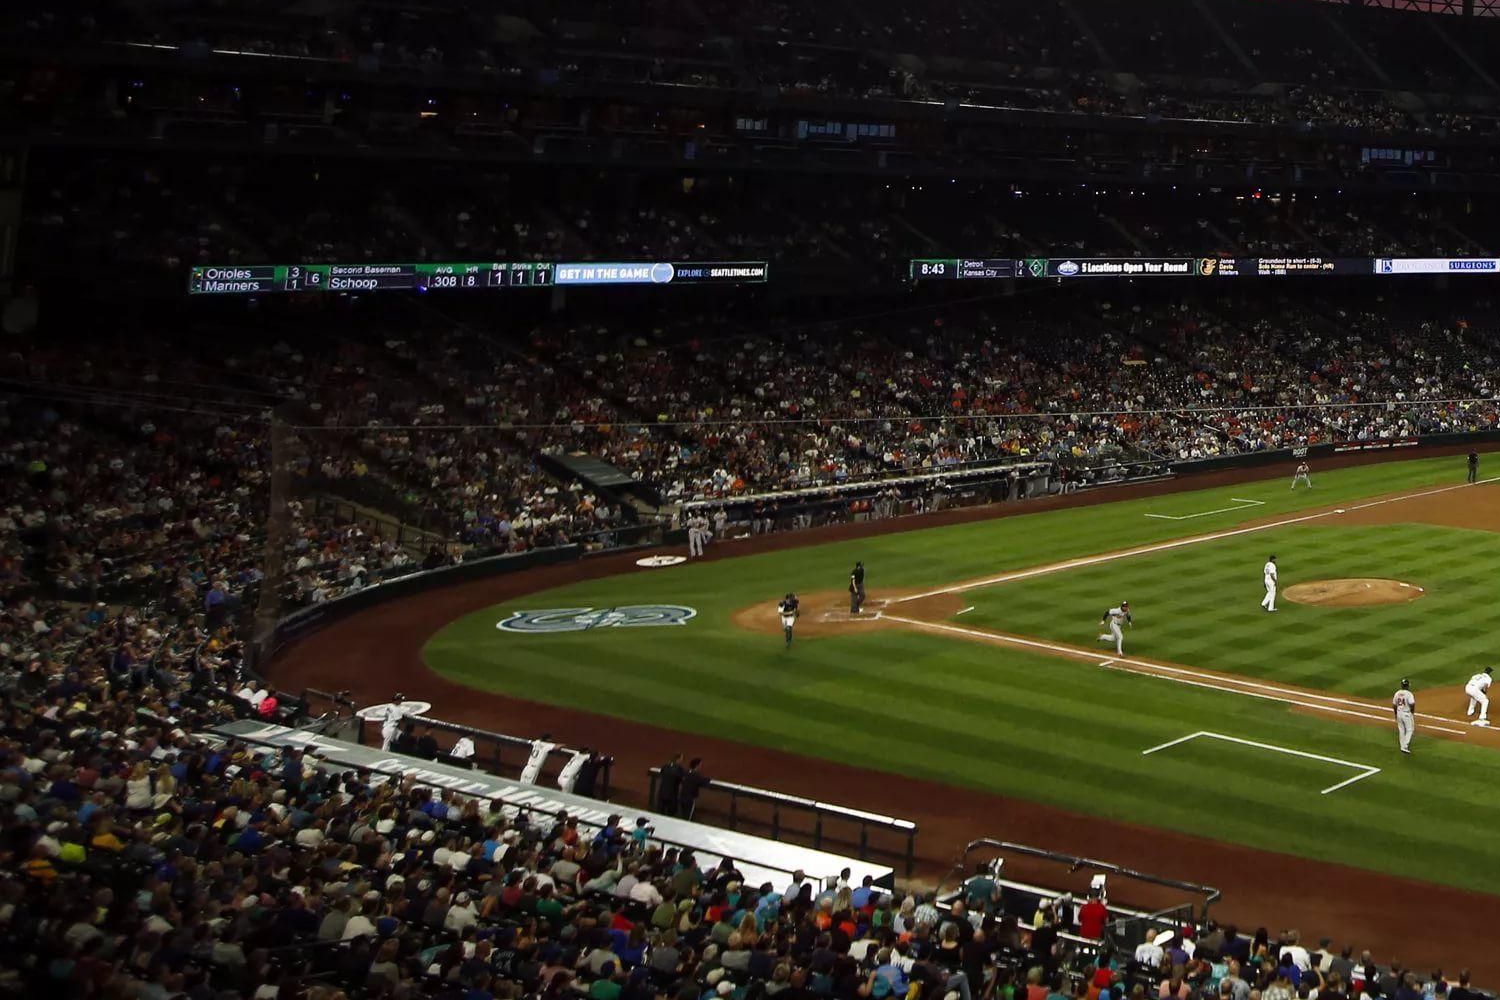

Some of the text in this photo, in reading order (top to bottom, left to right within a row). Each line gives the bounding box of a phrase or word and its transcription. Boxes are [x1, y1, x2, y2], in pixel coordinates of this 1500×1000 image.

[922, 263, 945, 274] 8:43
[964, 260, 983, 268] Detroit
[1088, 262, 1123, 273] Locations
[1124, 262, 1143, 274] Open
[1144, 262, 1162, 273] Year
[1164, 262, 1188, 273] Round
[207, 267, 300, 279] Orioles 3
[332, 267, 362, 275] Second
[559, 268, 649, 280] GET IN THE GAME
[677, 267, 764, 278] EXPLORE SEATTLETIMES.COM
[963, 269, 984, 277] Kansas
[985, 269, 998, 278] City
[312, 273, 320, 283] 6
[331, 277, 378, 290] Schoop
[431, 276, 475, 287] .308 8
[205, 280, 260, 291] Mariners
